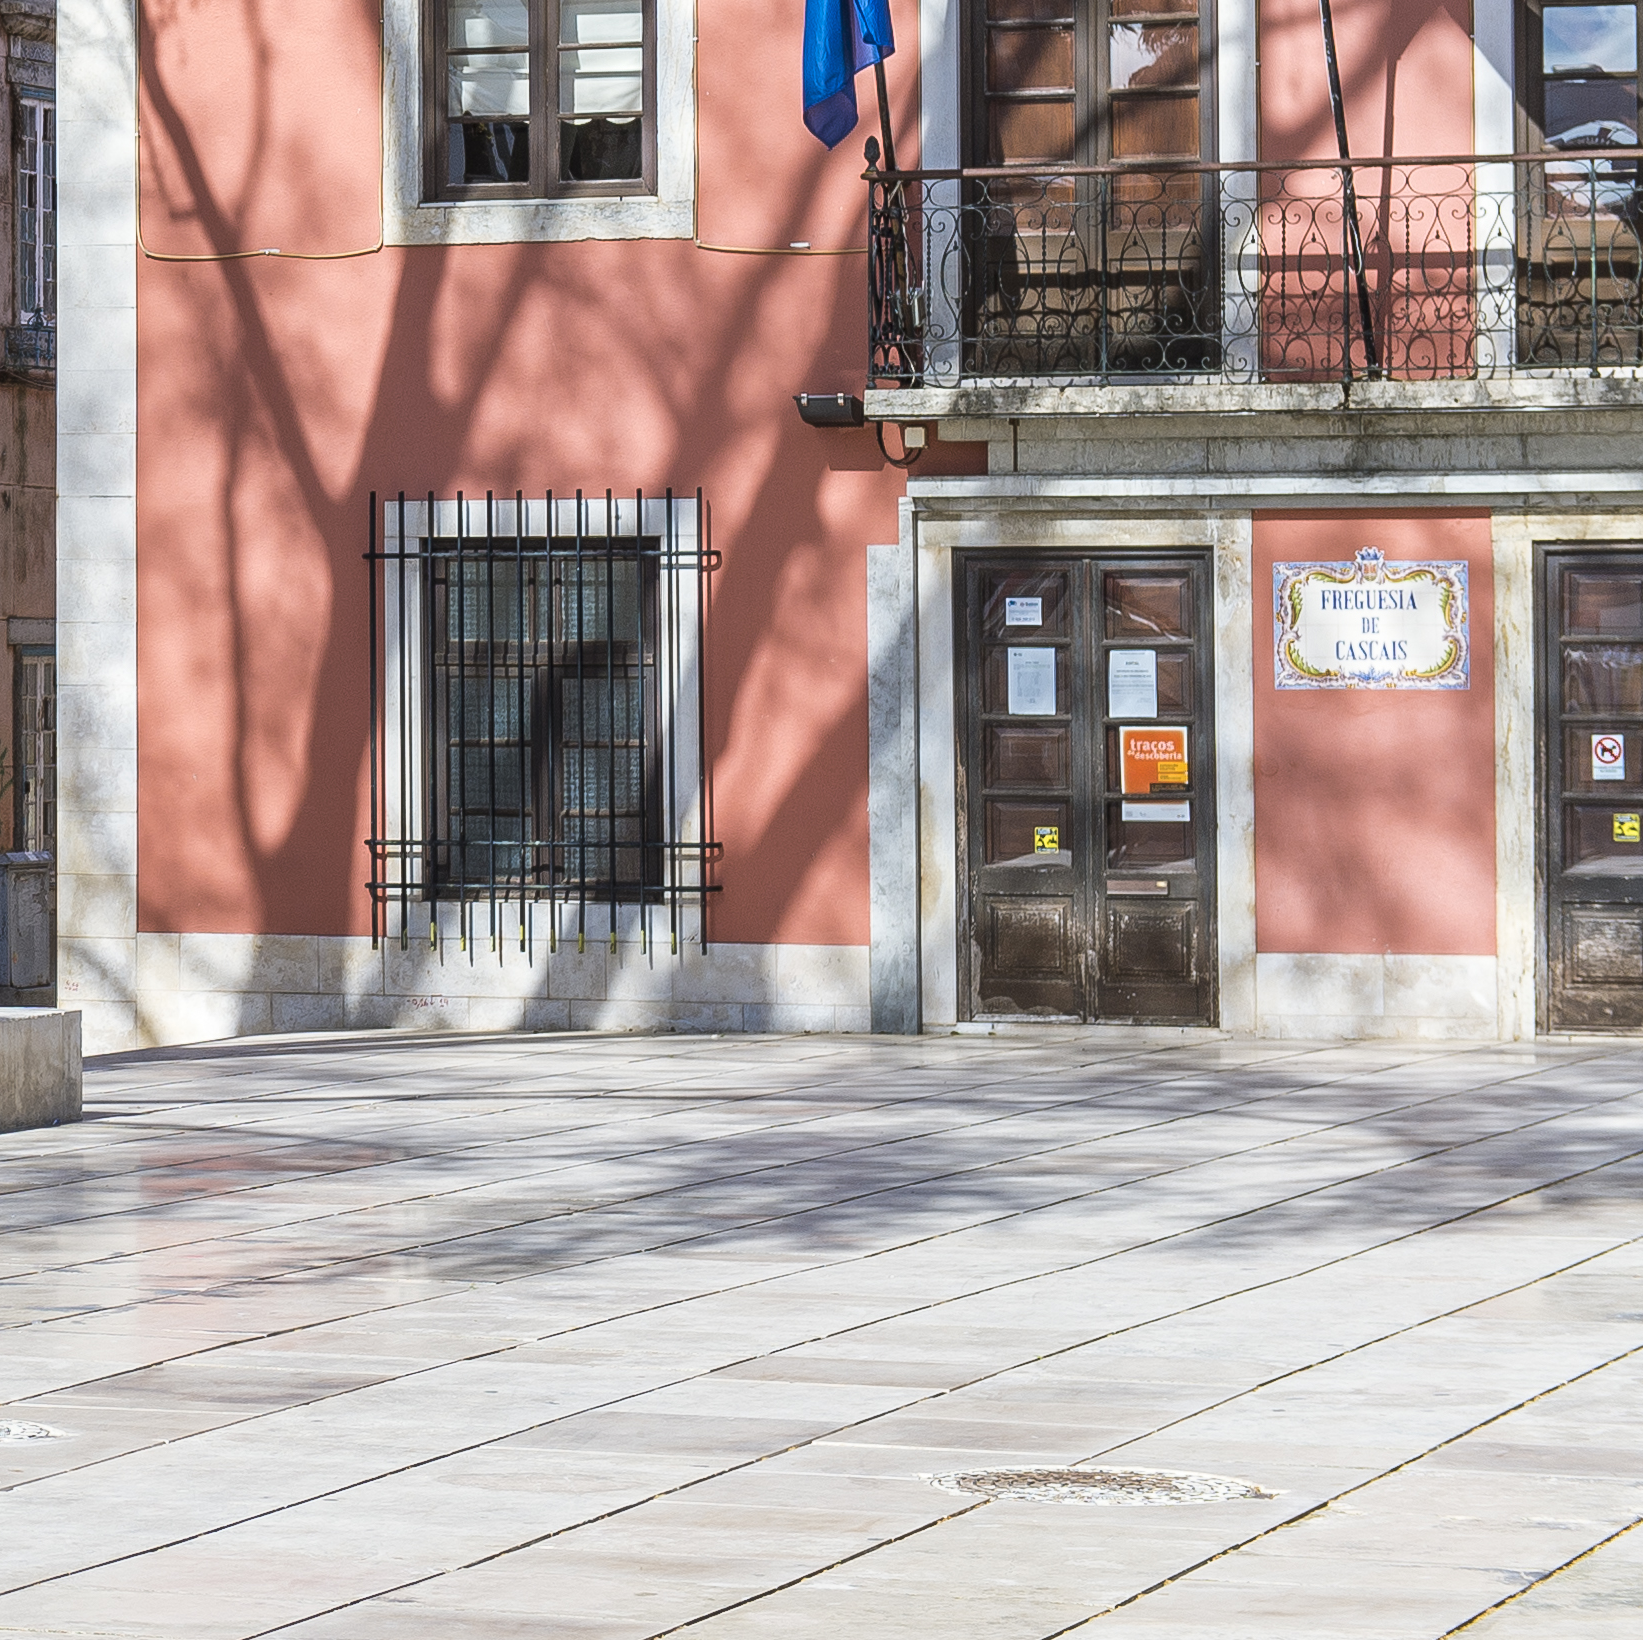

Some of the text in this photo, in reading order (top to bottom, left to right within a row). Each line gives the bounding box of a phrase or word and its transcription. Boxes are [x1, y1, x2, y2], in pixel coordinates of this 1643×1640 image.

[1321, 589, 1417, 610] FREGUESIA
[1361, 617, 1380, 634] DE
[1335, 640, 1408, 661] CASCAIS
